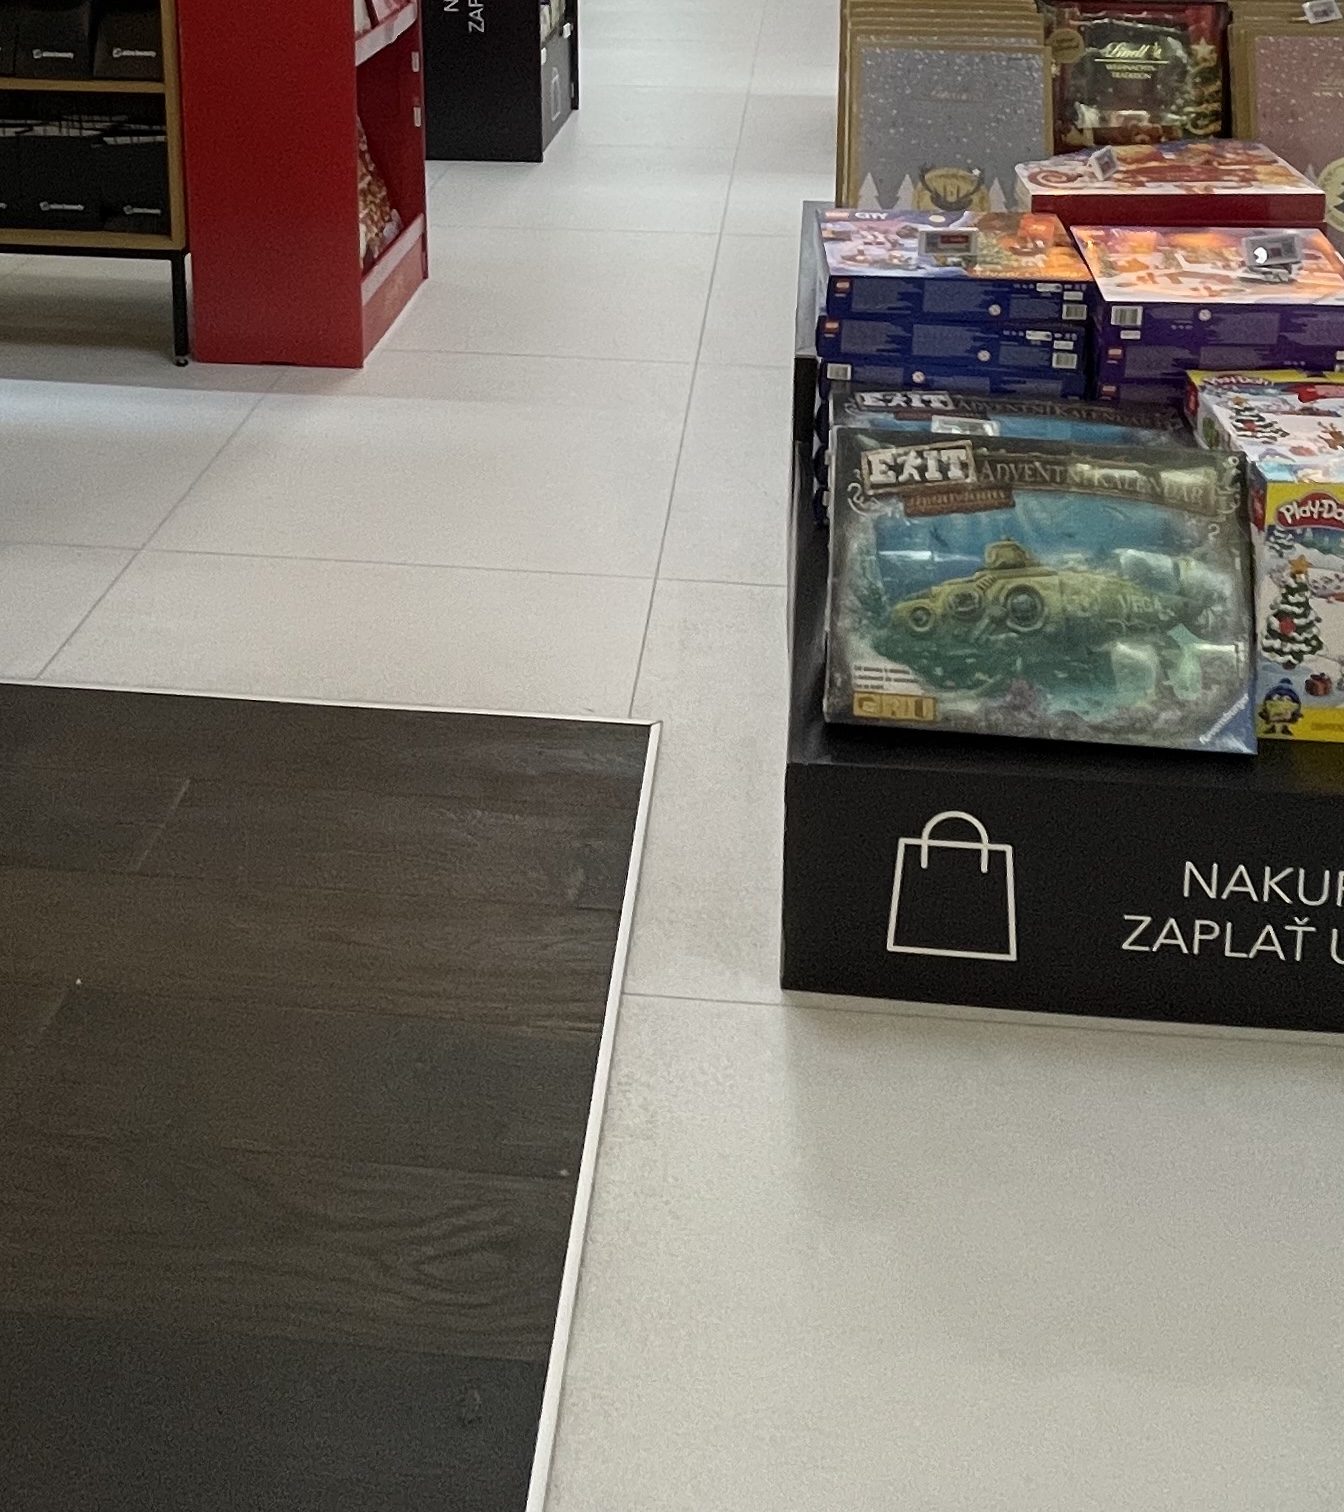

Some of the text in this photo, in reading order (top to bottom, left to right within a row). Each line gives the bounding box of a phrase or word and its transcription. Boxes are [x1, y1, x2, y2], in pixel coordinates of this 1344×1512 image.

[860, 391, 947, 408] EXIT
[867, 446, 970, 484] EXIT
[1121, 914, 1317, 966] ZAPLAŤ
